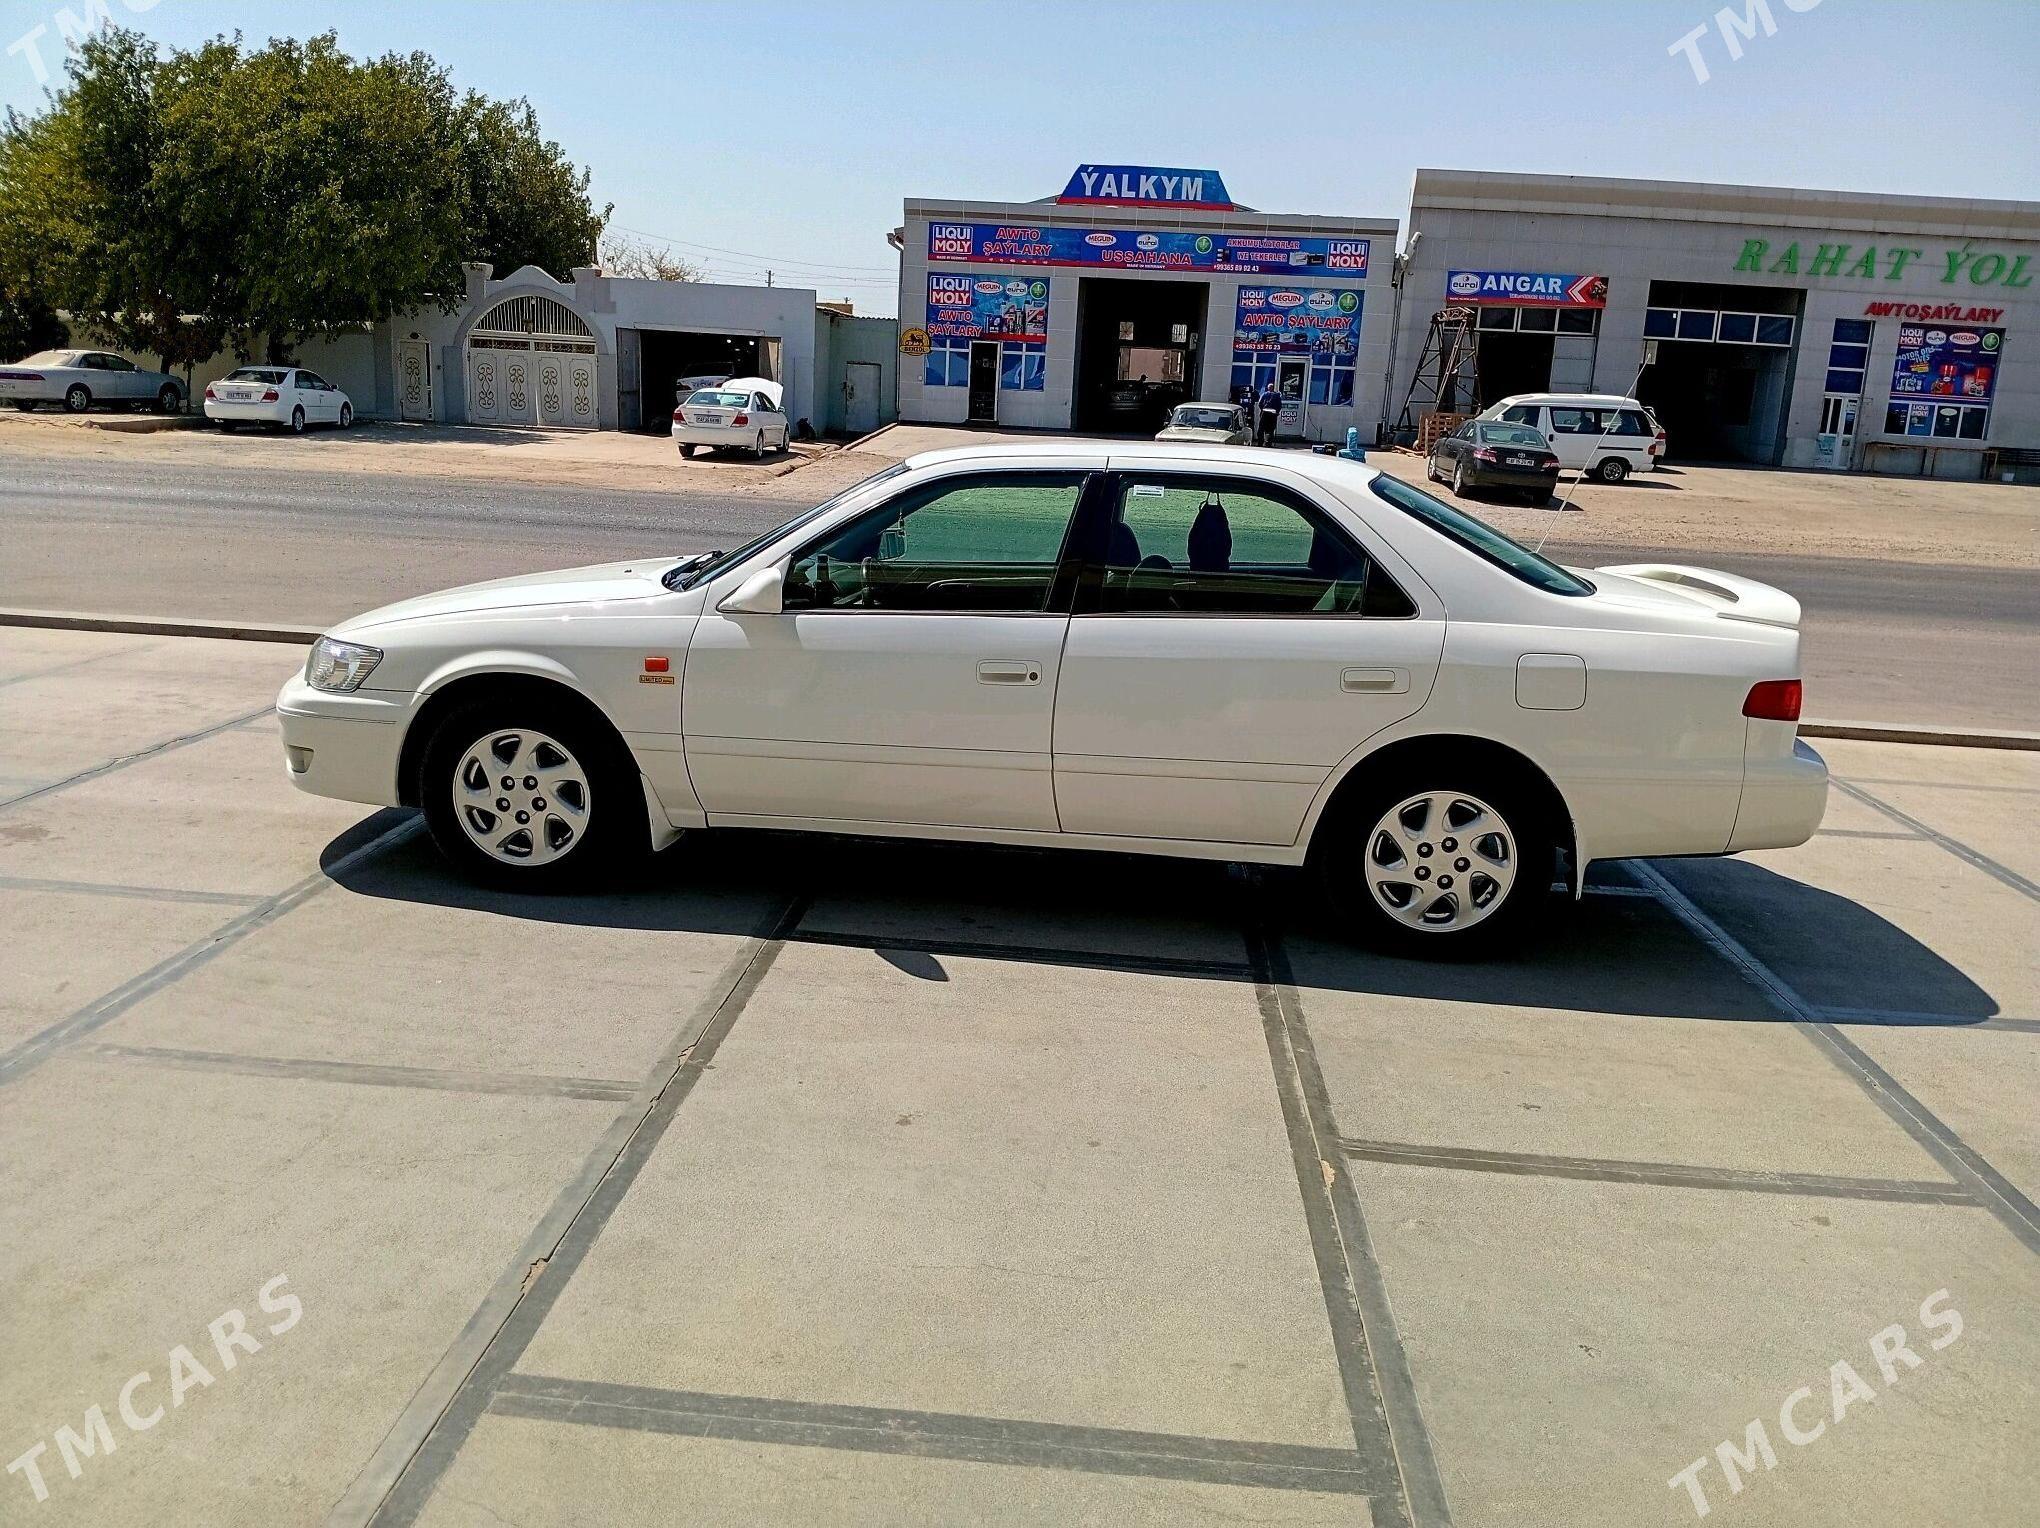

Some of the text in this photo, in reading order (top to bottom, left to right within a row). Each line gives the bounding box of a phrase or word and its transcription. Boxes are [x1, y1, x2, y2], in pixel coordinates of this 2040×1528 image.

[1080, 166, 1203, 201] ÝALKYM
[935, 226, 971, 240] LIQUI
[996, 227, 1041, 241] AWTO
[934, 239, 972, 253] MOLY
[983, 240, 1053, 256] ŞAÝLARY
[1330, 243, 1365, 256] LIQUI
[1101, 249, 1193, 265] USSAHANA
[1237, 251, 1288, 262] WE TEKERLER
[1328, 255, 1365, 268] MOLY
[1733, 239, 2034, 287] RAHAT ÝOL
[932, 277, 970, 291] LIQUI
[1452, 281, 1479, 289] eurol
[1482, 275, 1562, 293] ANGAR
[931, 290, 970, 304] MOLY
[1242, 290, 1264, 299] LIQUI
[1271, 295, 1301, 303] MEGUIN
[1241, 299, 1265, 307] MOLY
[1309, 298, 1333, 306] eurol
[938, 309, 973, 321] AWTO
[1864, 301, 2005, 323] AWTOŞAÝLARY
[1243, 313, 1284, 326] AWTO
[928, 322, 982, 337] ŞAÝLARY
[1901, 328, 1923, 337] LIQUI
[1900, 336, 1923, 346] MOLY
